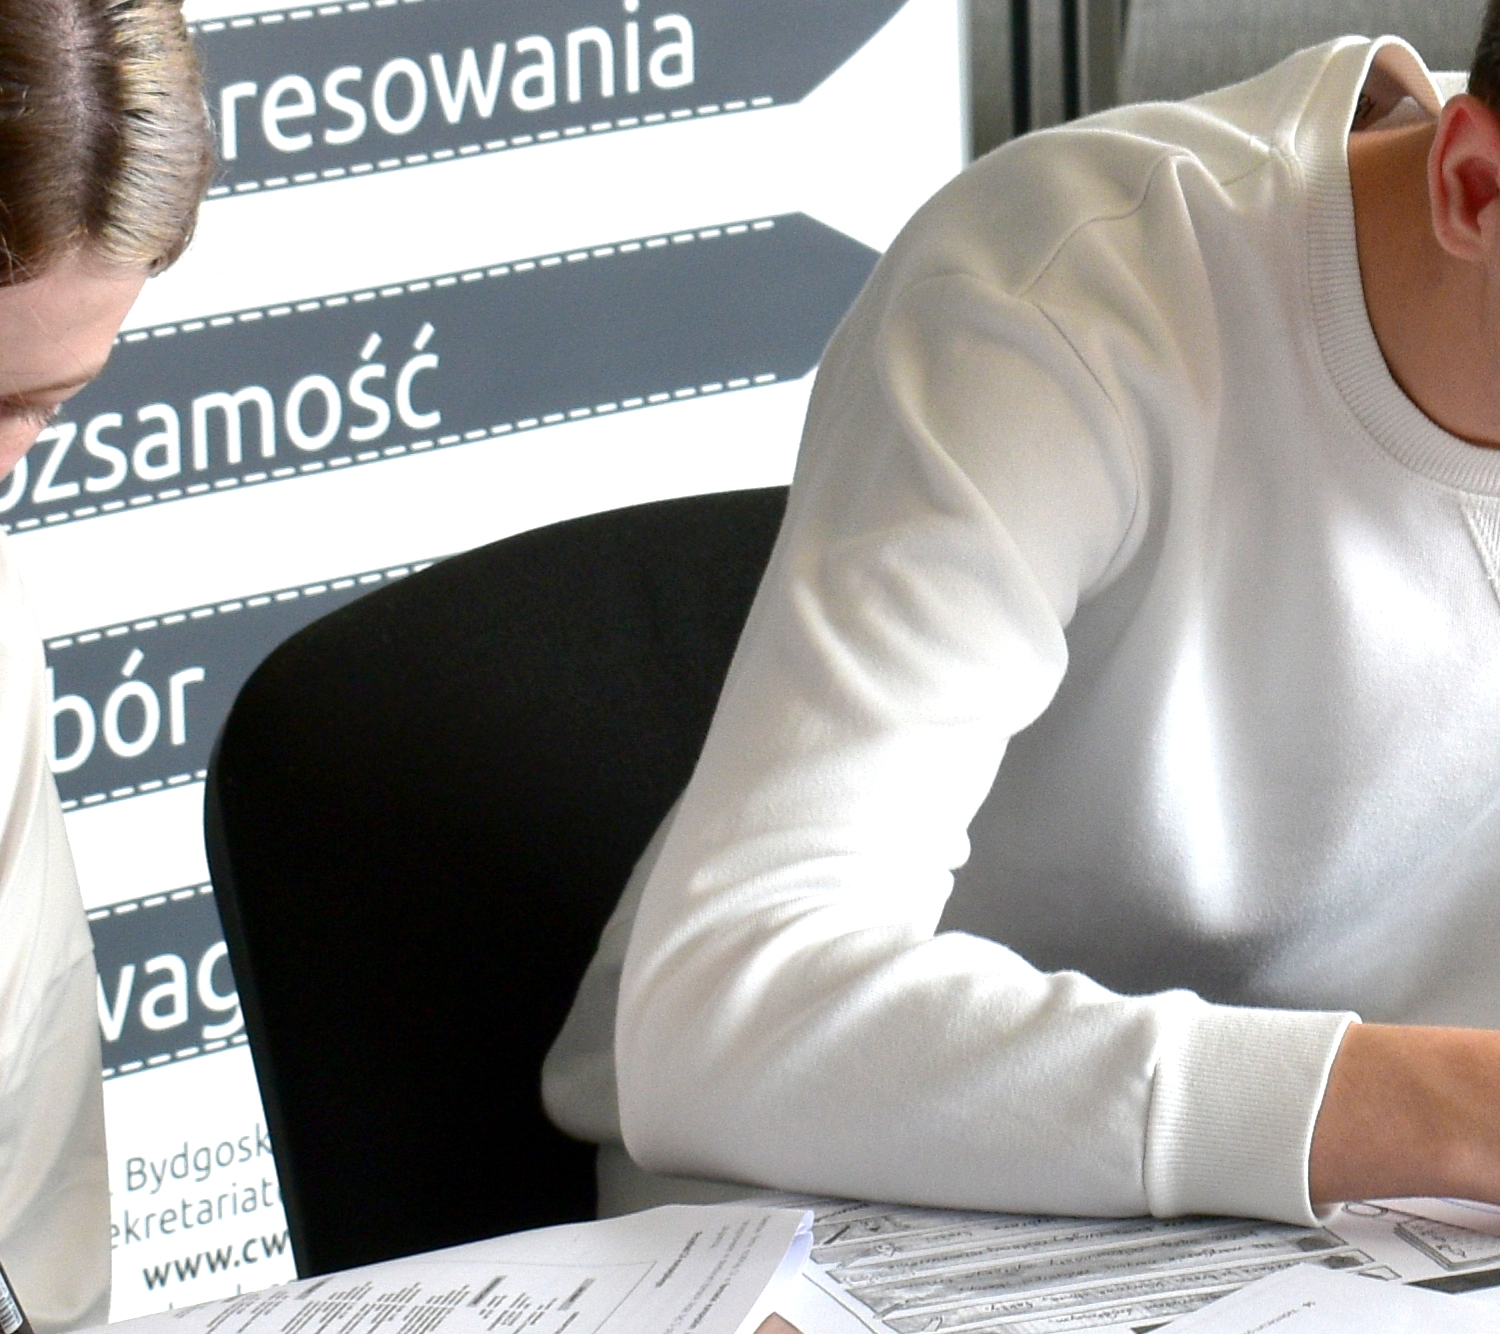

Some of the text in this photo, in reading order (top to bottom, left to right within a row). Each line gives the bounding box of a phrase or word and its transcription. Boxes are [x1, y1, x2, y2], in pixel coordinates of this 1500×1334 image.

[46, 649, 205, 774] bór
[126, 1123, 272, 1195] Bydgosk
[143, 1228, 290, 1291] www.cw
